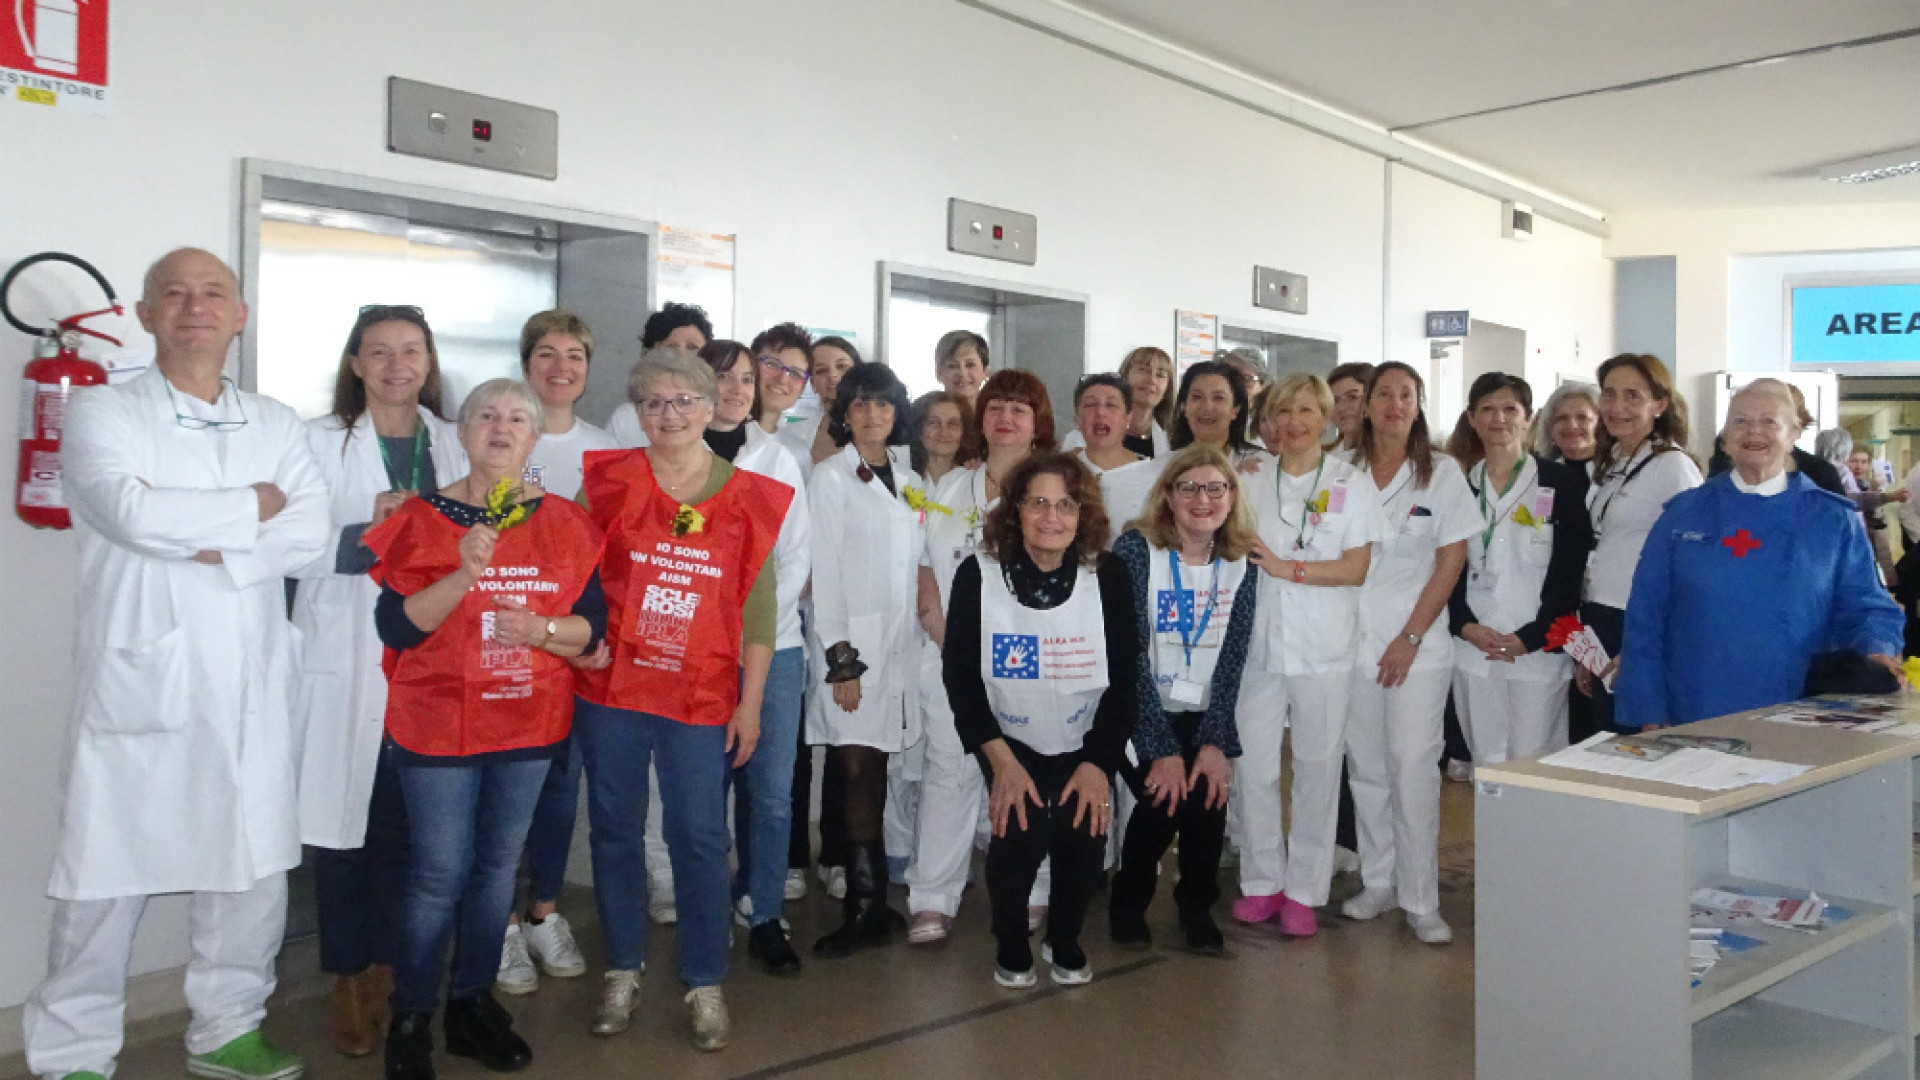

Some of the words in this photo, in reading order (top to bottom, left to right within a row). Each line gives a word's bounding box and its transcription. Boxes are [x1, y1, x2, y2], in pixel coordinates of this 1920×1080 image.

[1826, 311, 1920, 336] AREA
[656, 542, 671, 553] IO
[674, 546, 710, 560] SONO
[499, 566, 539, 577] SONO
[651, 555, 722, 578] VOLONTARI
[658, 571, 692, 586] AISM
